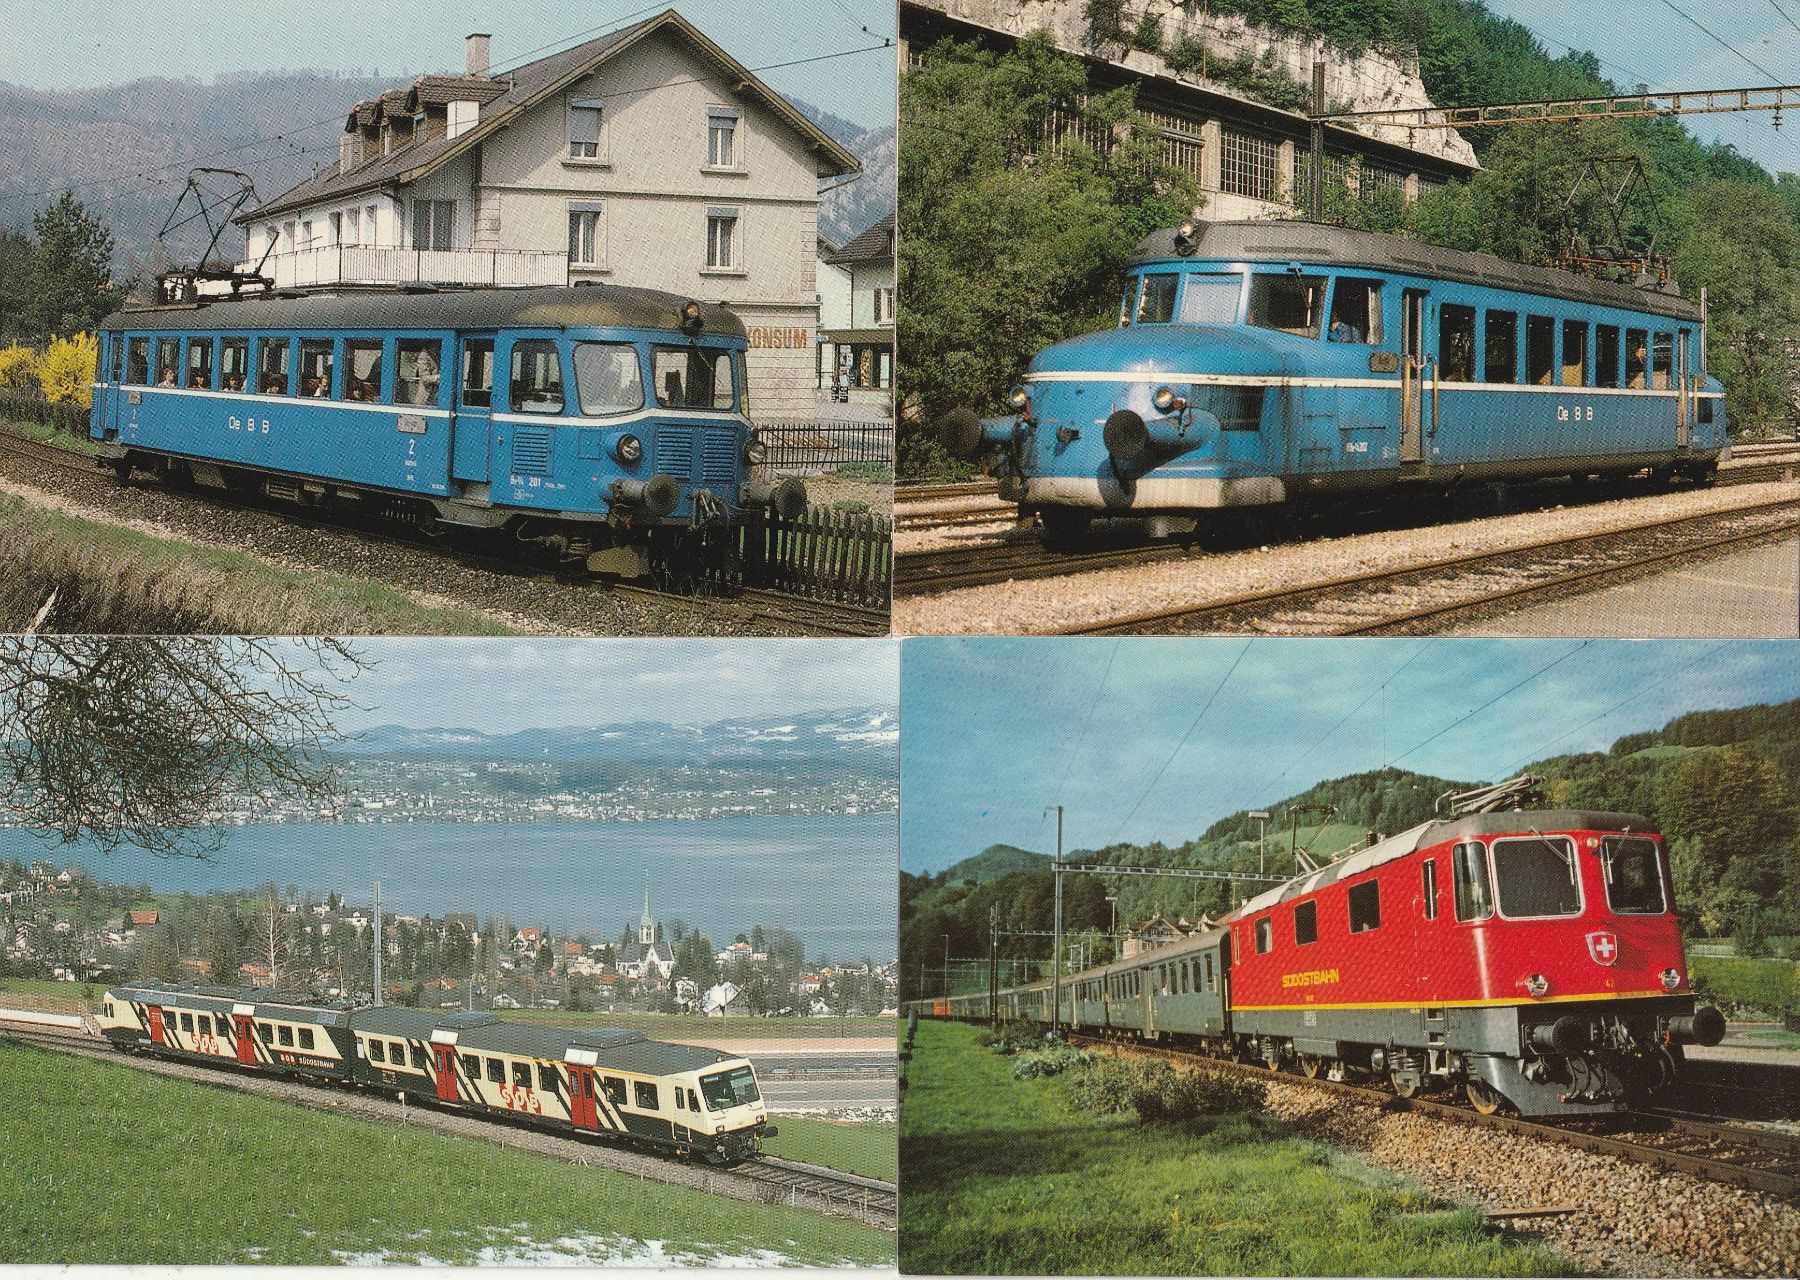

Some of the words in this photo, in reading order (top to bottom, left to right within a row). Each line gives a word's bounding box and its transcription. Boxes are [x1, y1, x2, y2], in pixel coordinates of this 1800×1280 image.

[746, 327, 807, 349] KONSUM
[407, 438, 416, 455] 2
[528, 476, 541, 487] 201
[500, 1087, 541, 1114] SOB
